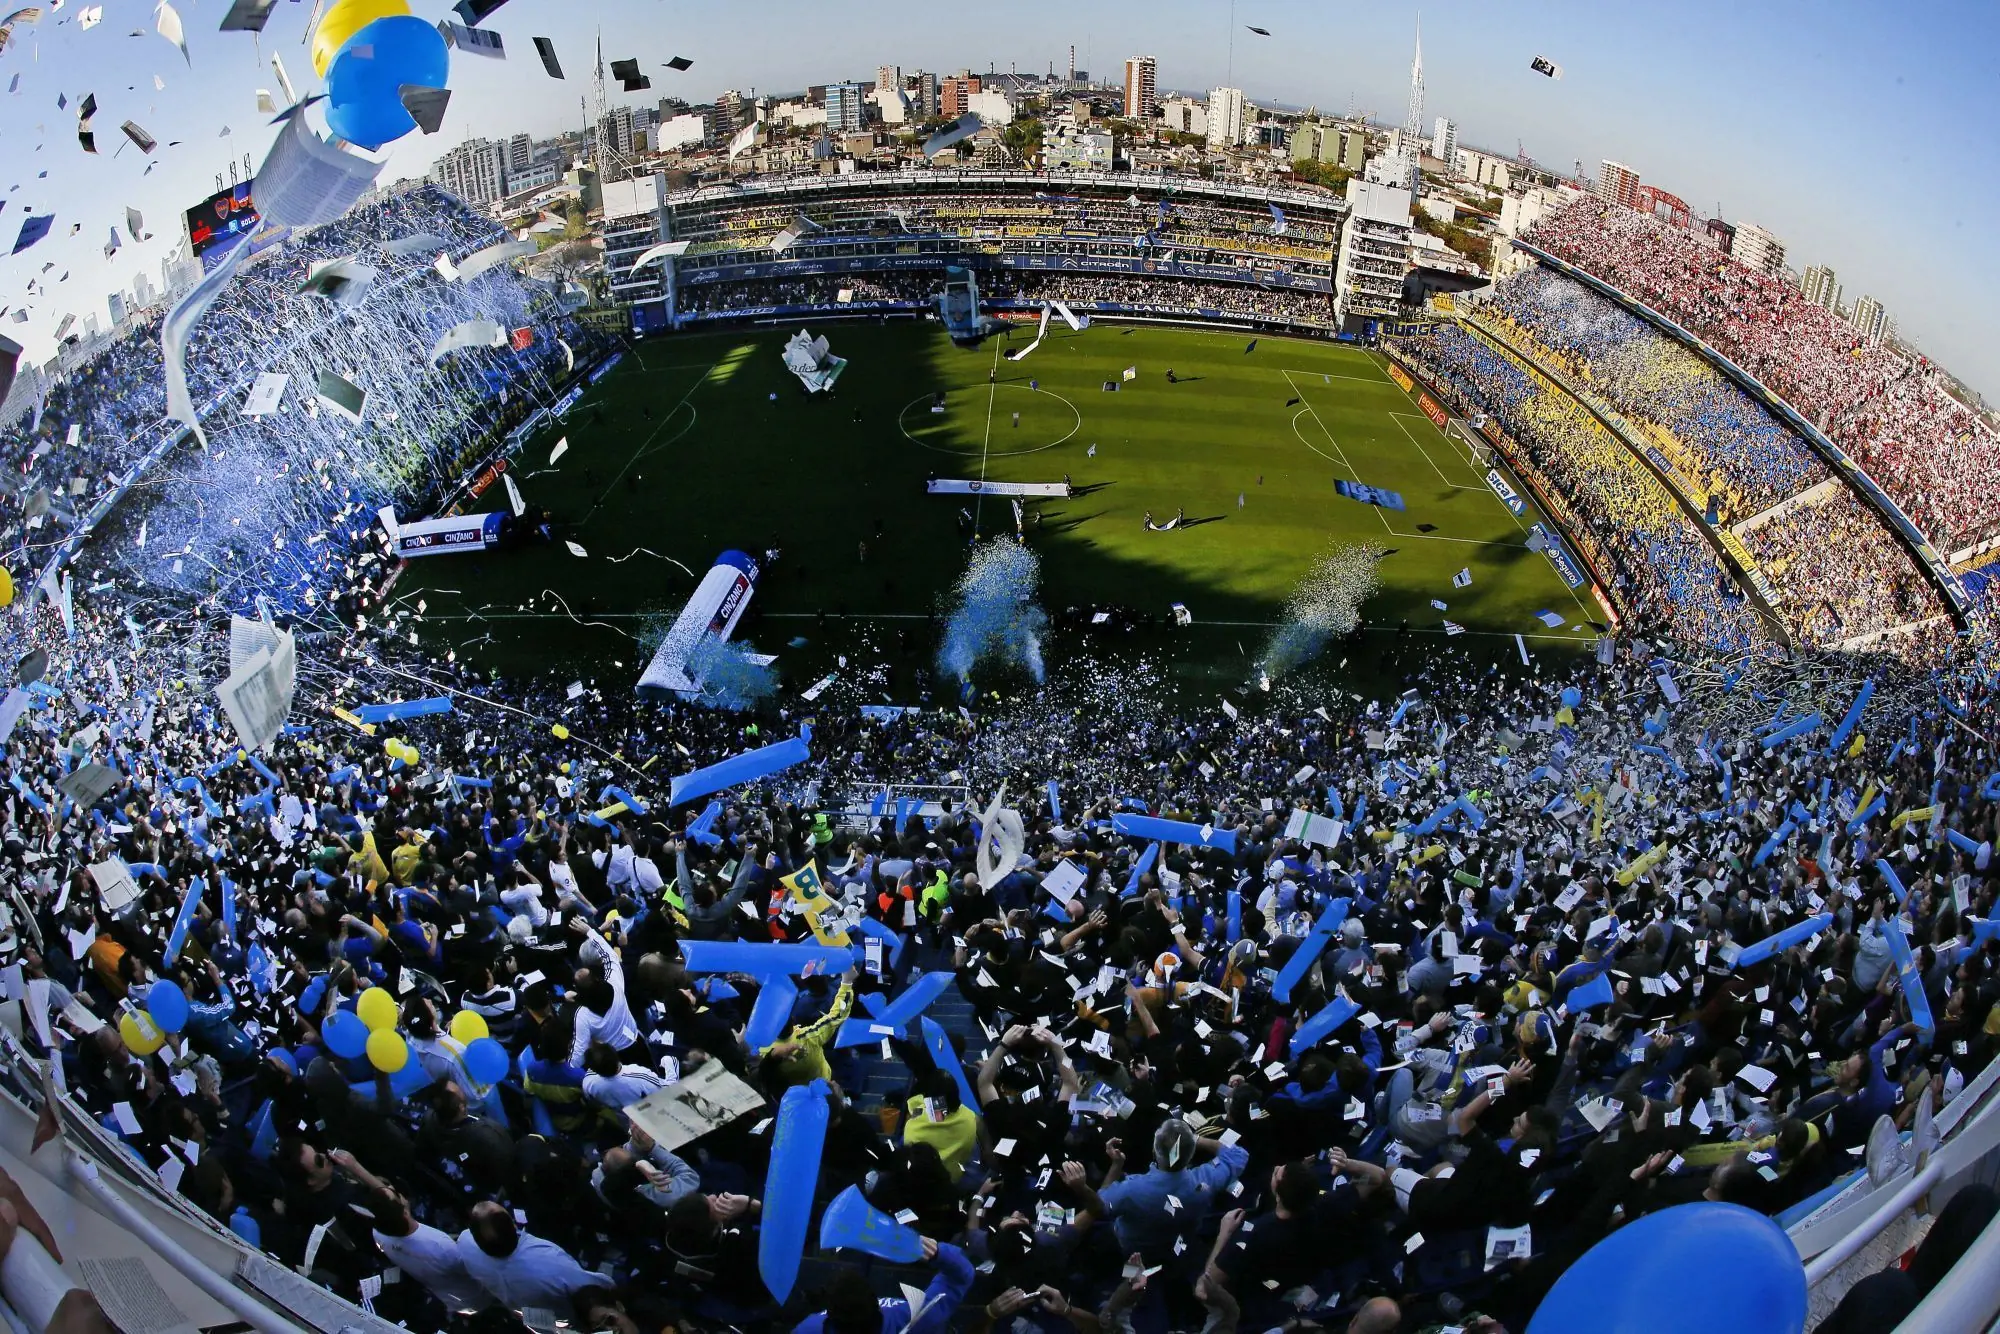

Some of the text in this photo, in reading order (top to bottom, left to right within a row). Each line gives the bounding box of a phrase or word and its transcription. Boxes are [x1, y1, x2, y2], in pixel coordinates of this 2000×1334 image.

[813, 301, 880, 311] LA NUEVA
[1134, 304, 1202, 315] LA NUEVA
[1219, 310, 1255, 320] flecha
[1557, 367, 1588, 392] ANDERSON
[552, 394, 572, 417] sica
[1421, 395, 1437, 417] easy
[1470, 328, 1501, 352] SIEMPRE
[1552, 386, 1574, 408] LADO
[1573, 405, 1598, 430] BOCA
[1598, 427, 1635, 464] JUNIORS
[1632, 460, 1672, 505] QUERIDO
[1488, 472, 1511, 498] sica
[444, 531, 474, 543] CINZANO
[1555, 555, 1578, 584] Seguros
[720, 583, 744, 619] CINZANO
